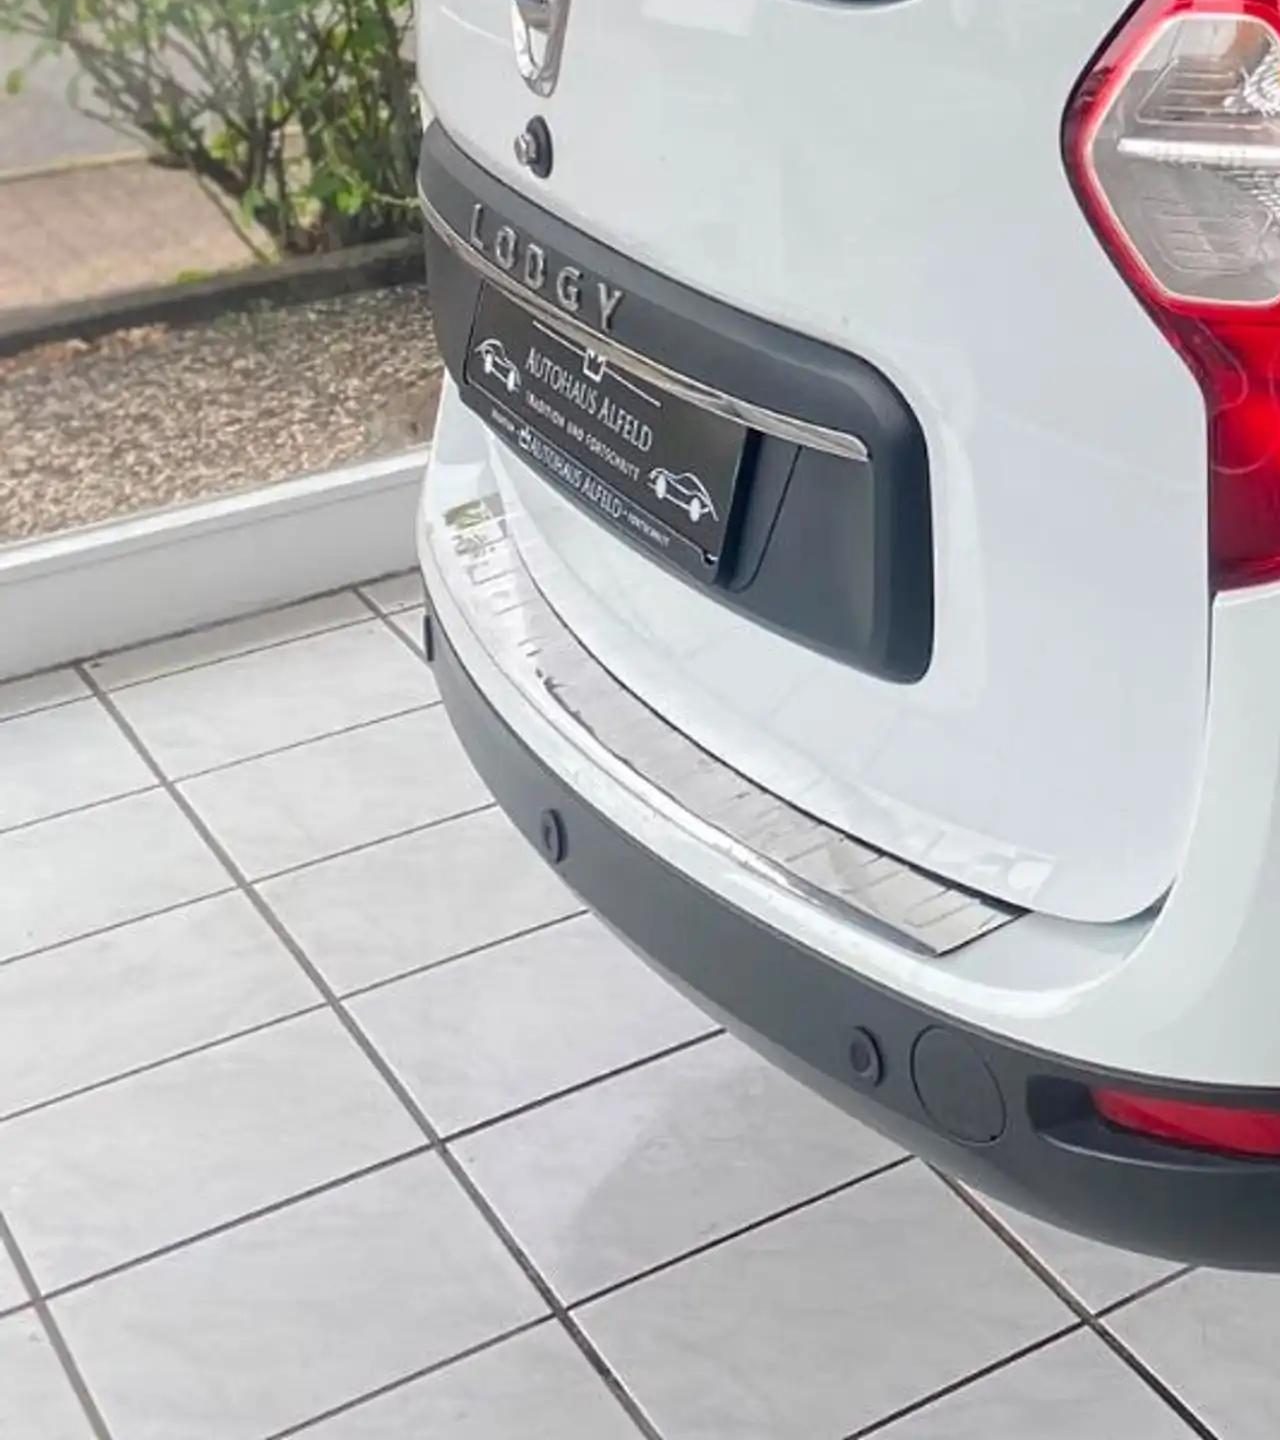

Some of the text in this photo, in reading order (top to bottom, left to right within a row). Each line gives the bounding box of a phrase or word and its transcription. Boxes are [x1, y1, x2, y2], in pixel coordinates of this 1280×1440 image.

[470, 203, 623, 334] LODGY
[525, 347, 653, 452] AUTOHAUS ALFELD
[530, 435, 581, 489] AUTOHAUS
[580, 476, 622, 518] ALFELD
